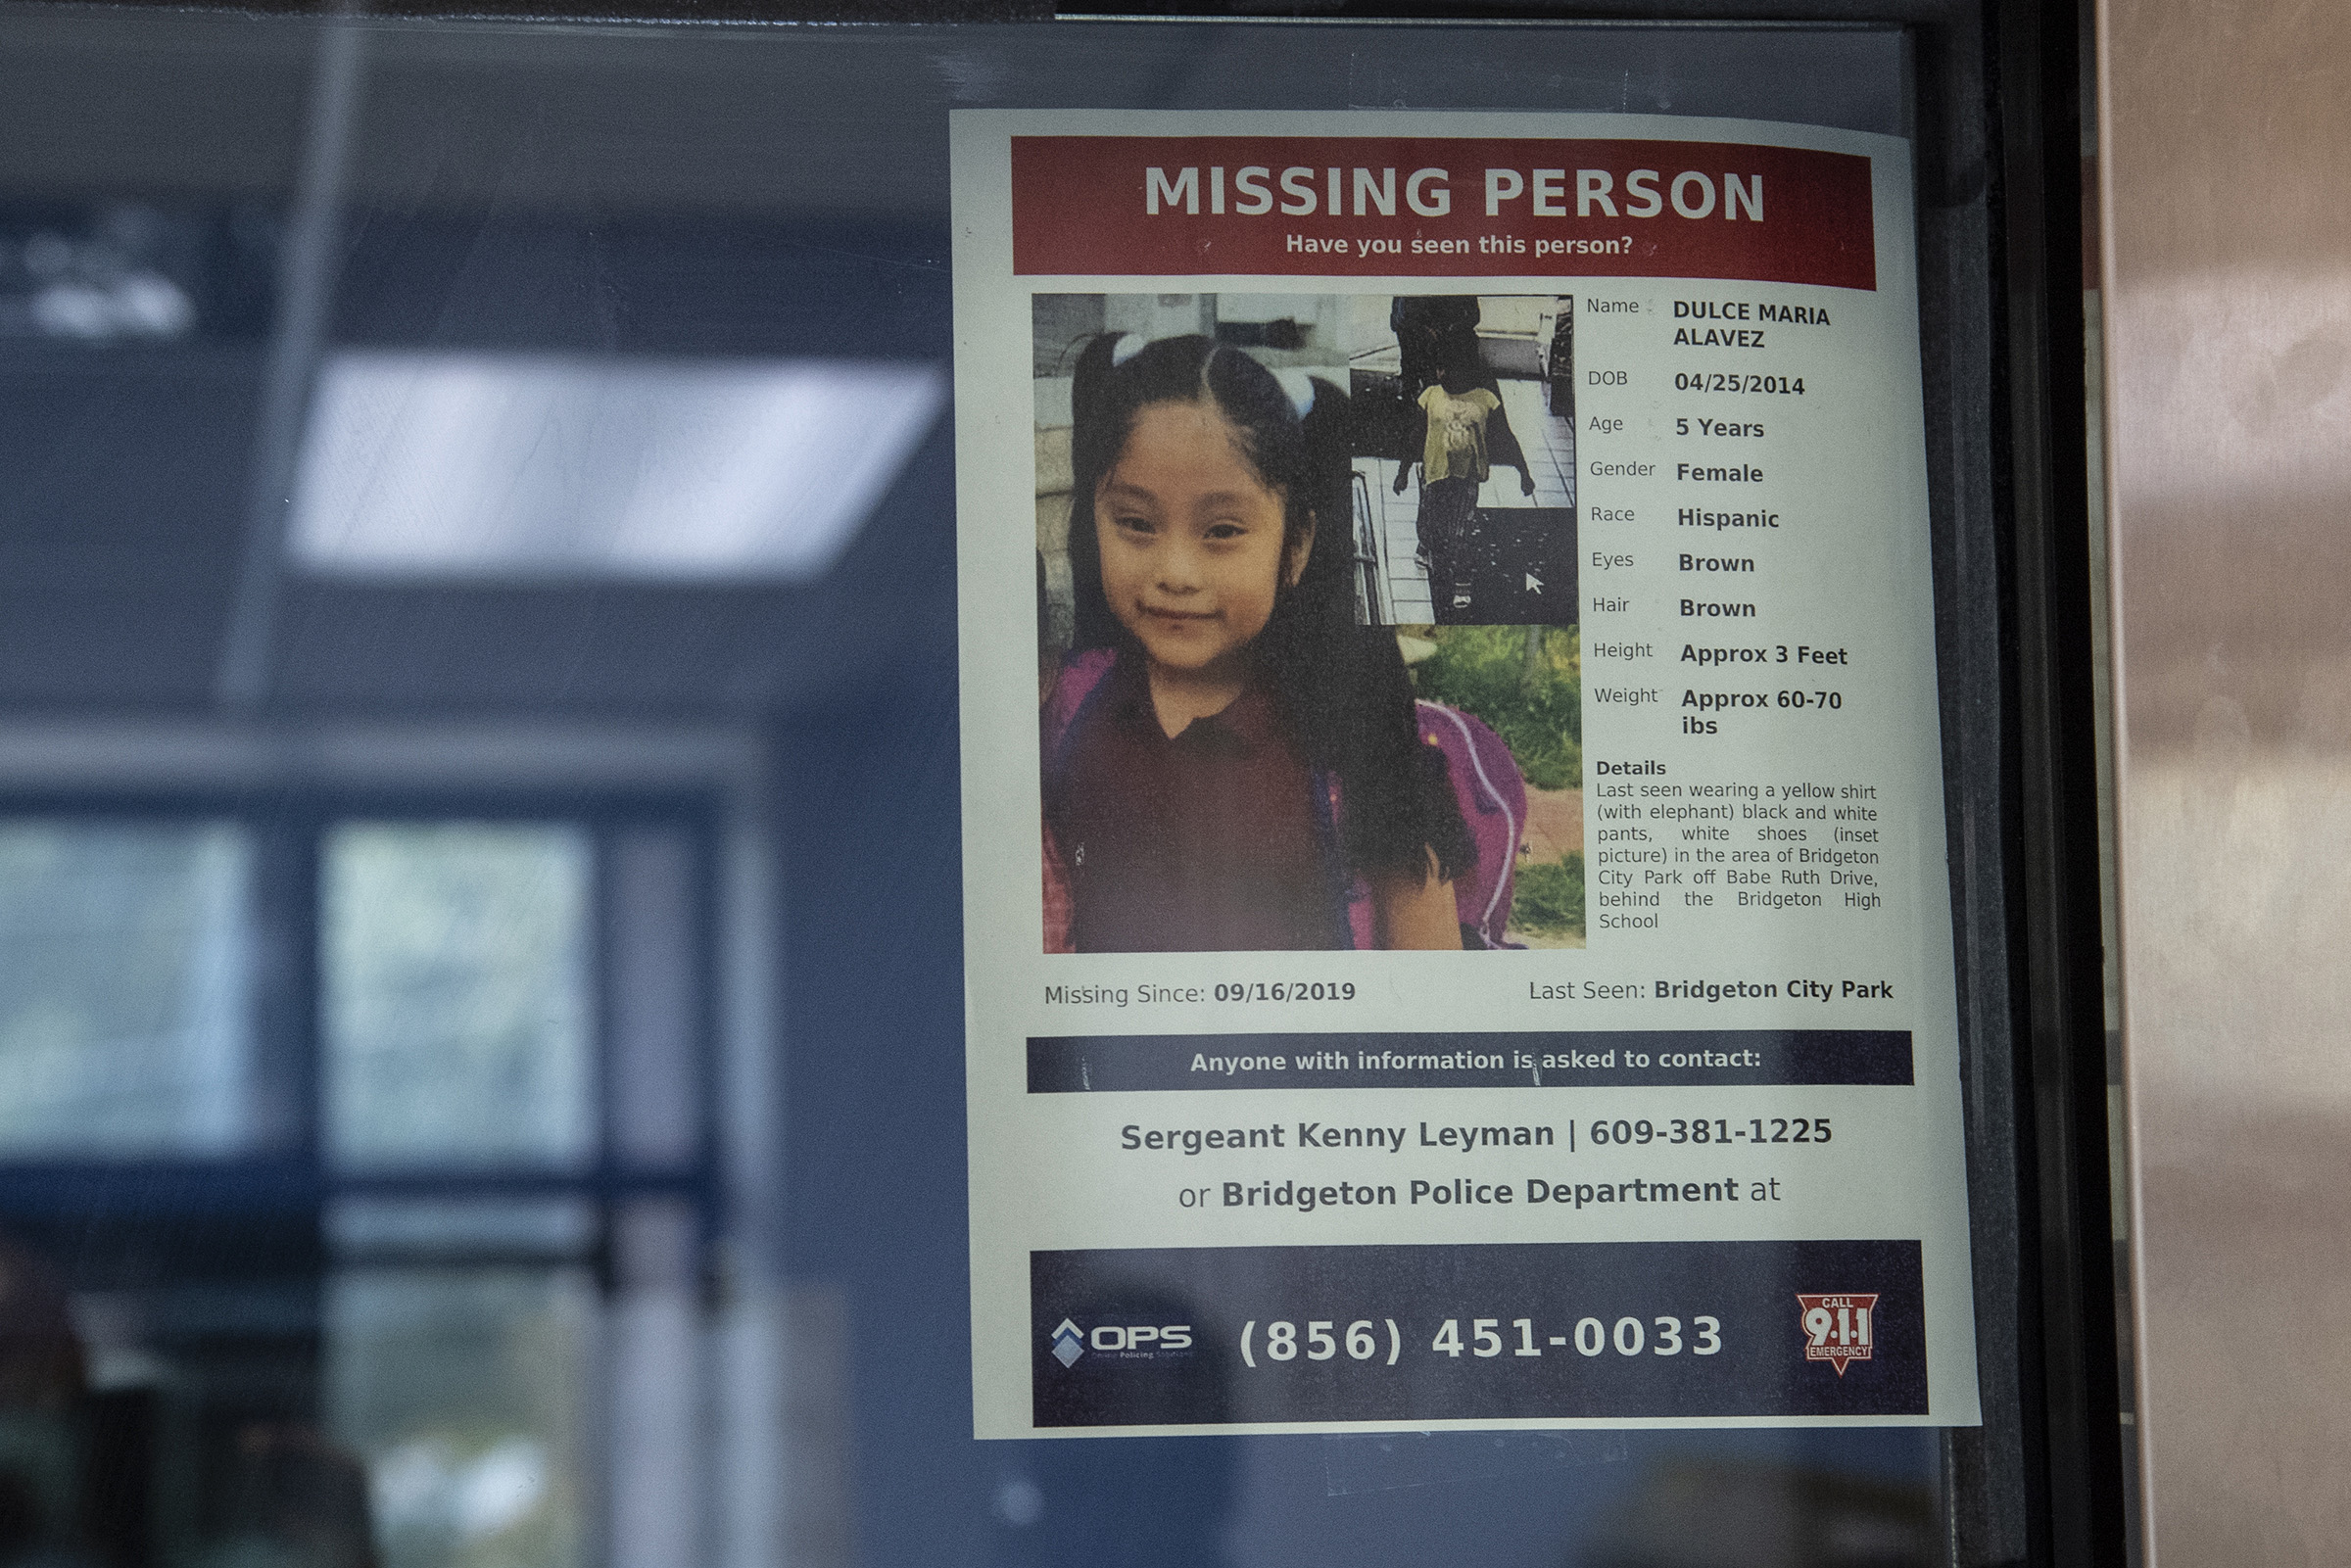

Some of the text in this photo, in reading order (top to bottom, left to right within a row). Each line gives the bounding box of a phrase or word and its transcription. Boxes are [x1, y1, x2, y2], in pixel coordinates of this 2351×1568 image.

[1146, 166, 1763, 221] MISSING PERSON
[1287, 235, 1632, 258] Have you seen this person?
[1588, 299, 1830, 325] Name DULCE MARIA
[1674, 328, 1764, 348] ALAVEZ
[1589, 371, 1805, 395] DOB 04/25/2014
[1589, 416, 1764, 437] Age 5 Years
[1590, 461, 1763, 482] Gender Female
[1592, 507, 1779, 531] Race Hispanic
[1593, 552, 1753, 572] Eyes Brown
[1594, 597, 1755, 617] Hair Brown
[1595, 642, 1847, 666] Height Approx 3 Feet
[1595, 689, 1842, 711] Weight Approx 60-70
[1683, 716, 1717, 734] ibs
[1597, 760, 1665, 775] Details
[1597, 783, 1877, 800] Last seen wearing a yellow shirt
[1598, 804, 1877, 822] (with elephant) black and white
[1599, 826, 1879, 844] pants, white shoes (inset
[1599, 847, 1879, 867] picture) in the area of Bridgeton
[1599, 869, 1877, 888] City Park off Babe Ruth Drive,
[1600, 891, 1881, 911] behind the Bridgeton High
[1600, 913, 1657, 928] School
[1045, 982, 1355, 1007] Missing Since: 09/16/2019
[1530, 979, 1893, 1003] Last Seen: Bridgeton City Park
[1191, 1050, 1760, 1075] Anyone with information is asked to contact:
[1122, 1124, 1284, 1156] Sergeant
[1299, 1123, 1406, 1153] Kenny
[1420, 1122, 1553, 1153] Leyman
[1591, 1118, 1832, 1144] 609-381-1225
[1179, 1177, 1781, 1212] or Bridgeton Police Department at
[1823, 1298, 1853, 1307] CALL
[1091, 1326, 1192, 1350] OPS
[1241, 1316, 1721, 1367] (856) 451-0033
[1810, 1347, 1867, 1356] EMERGENCY
